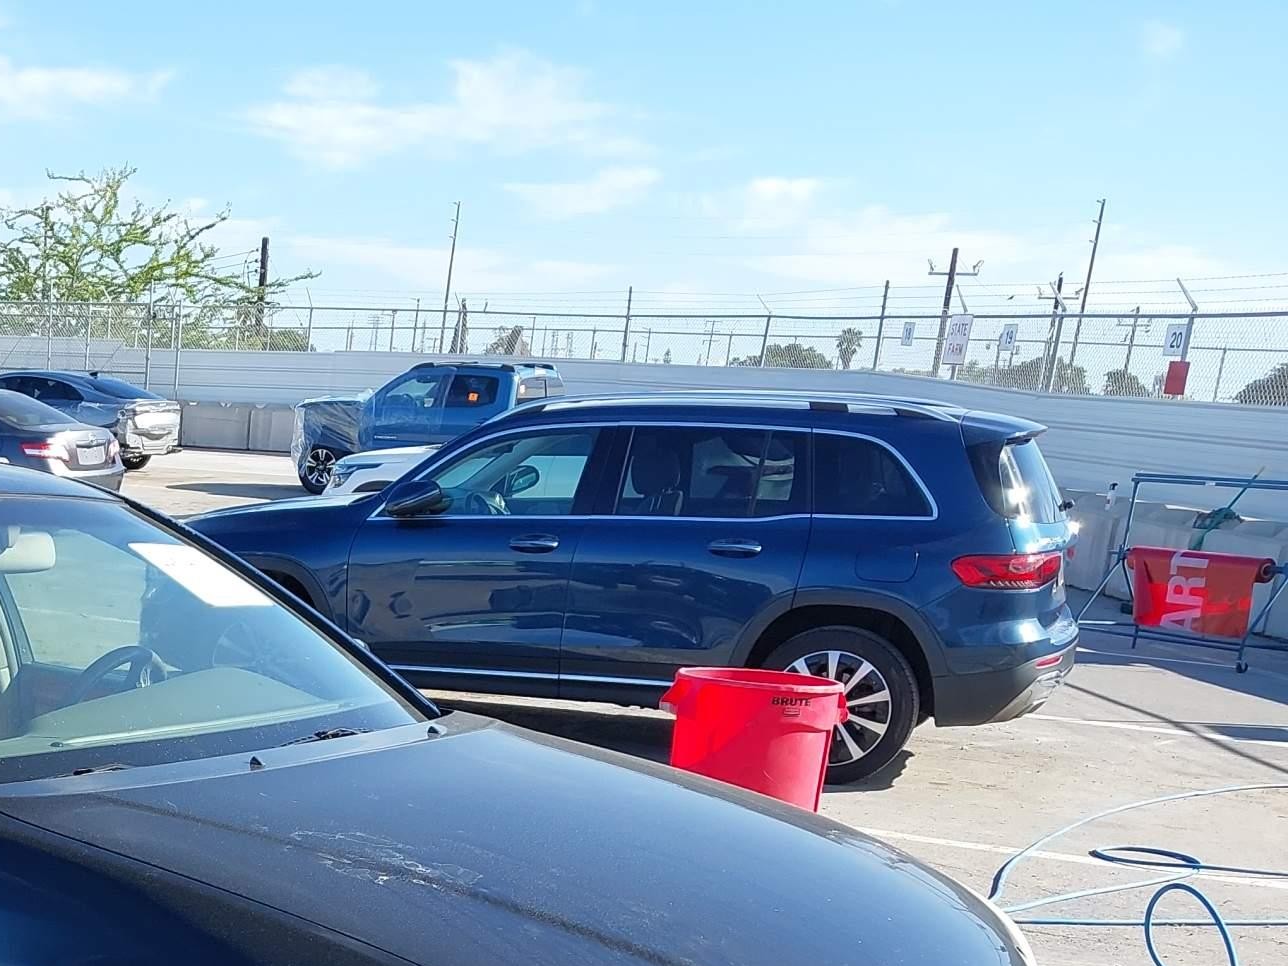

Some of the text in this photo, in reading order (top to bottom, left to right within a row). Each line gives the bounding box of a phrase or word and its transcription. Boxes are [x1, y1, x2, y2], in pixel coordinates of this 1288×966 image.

[951, 323, 969, 337] STATE
[1004, 330, 1014, 345] 19
[1169, 331, 1183, 349] 20
[772, 697, 811, 707] BRUTE
